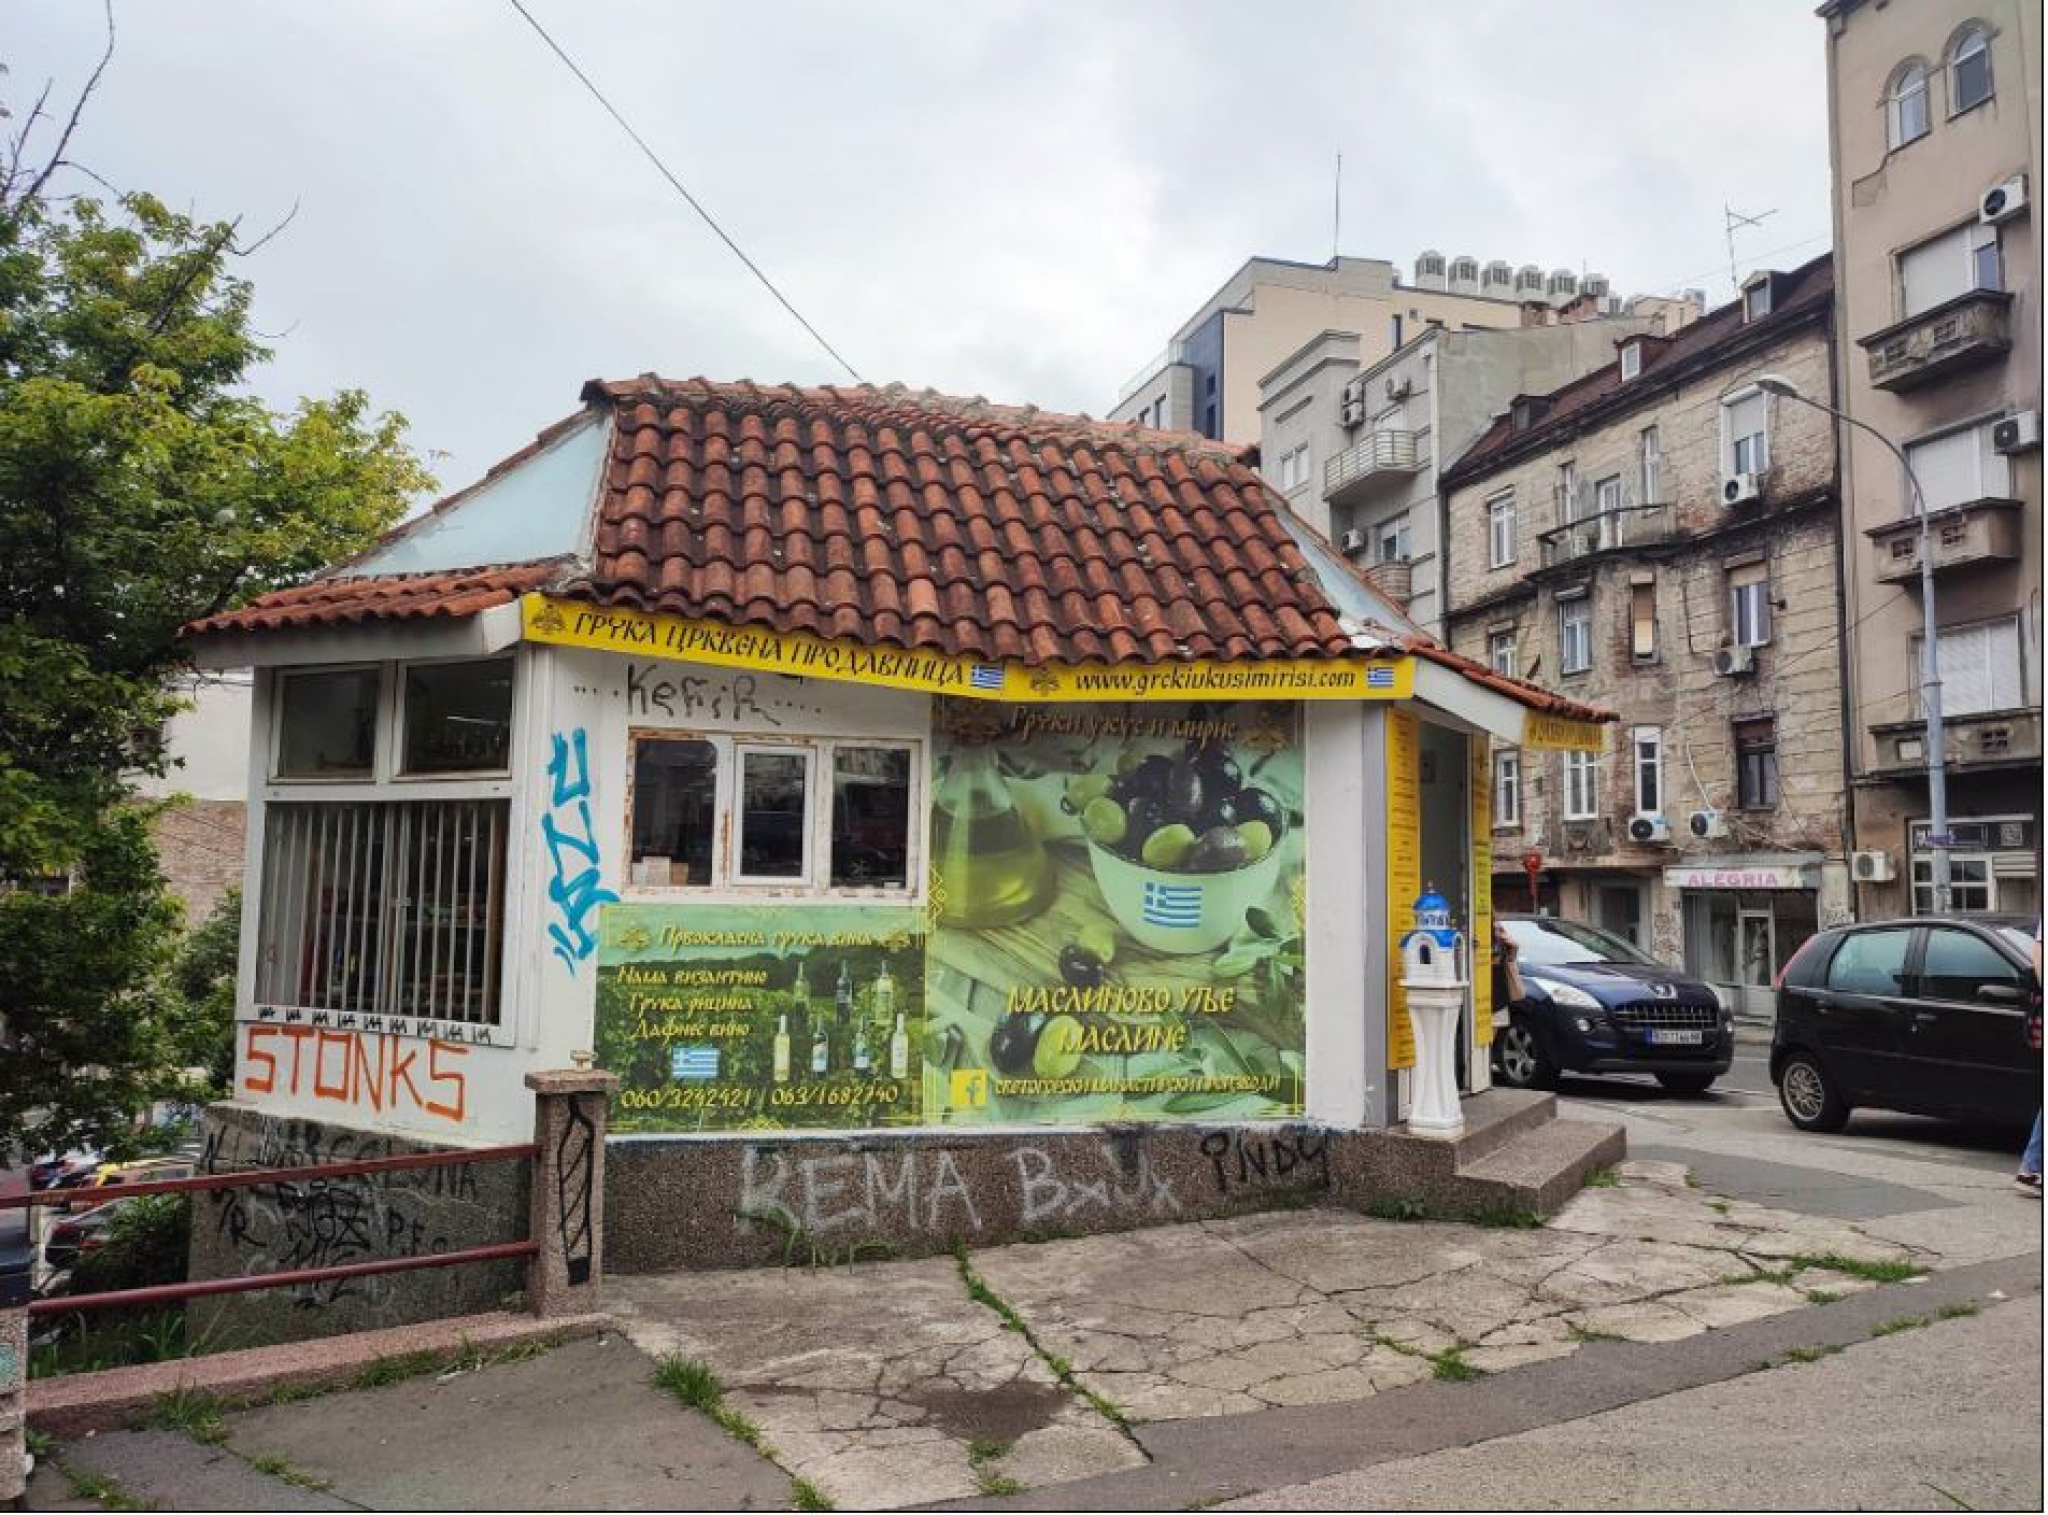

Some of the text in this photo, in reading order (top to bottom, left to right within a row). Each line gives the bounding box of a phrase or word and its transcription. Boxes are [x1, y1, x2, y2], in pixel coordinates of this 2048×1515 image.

[574, 612, 964, 687] ГРЧКА ЦРКВЕНА ПРОДАВНИЦА
[1075, 666, 1356, 696] www.grckiukusimirisi.com
[1688, 873, 1778, 887] ALEGRIA
[1006, 986, 1172, 1016] МАСЛИНОВО
[1057, 1024, 1187, 1053] МАСЛИНЕ
[244, 1024, 469, 1122] STONKS
